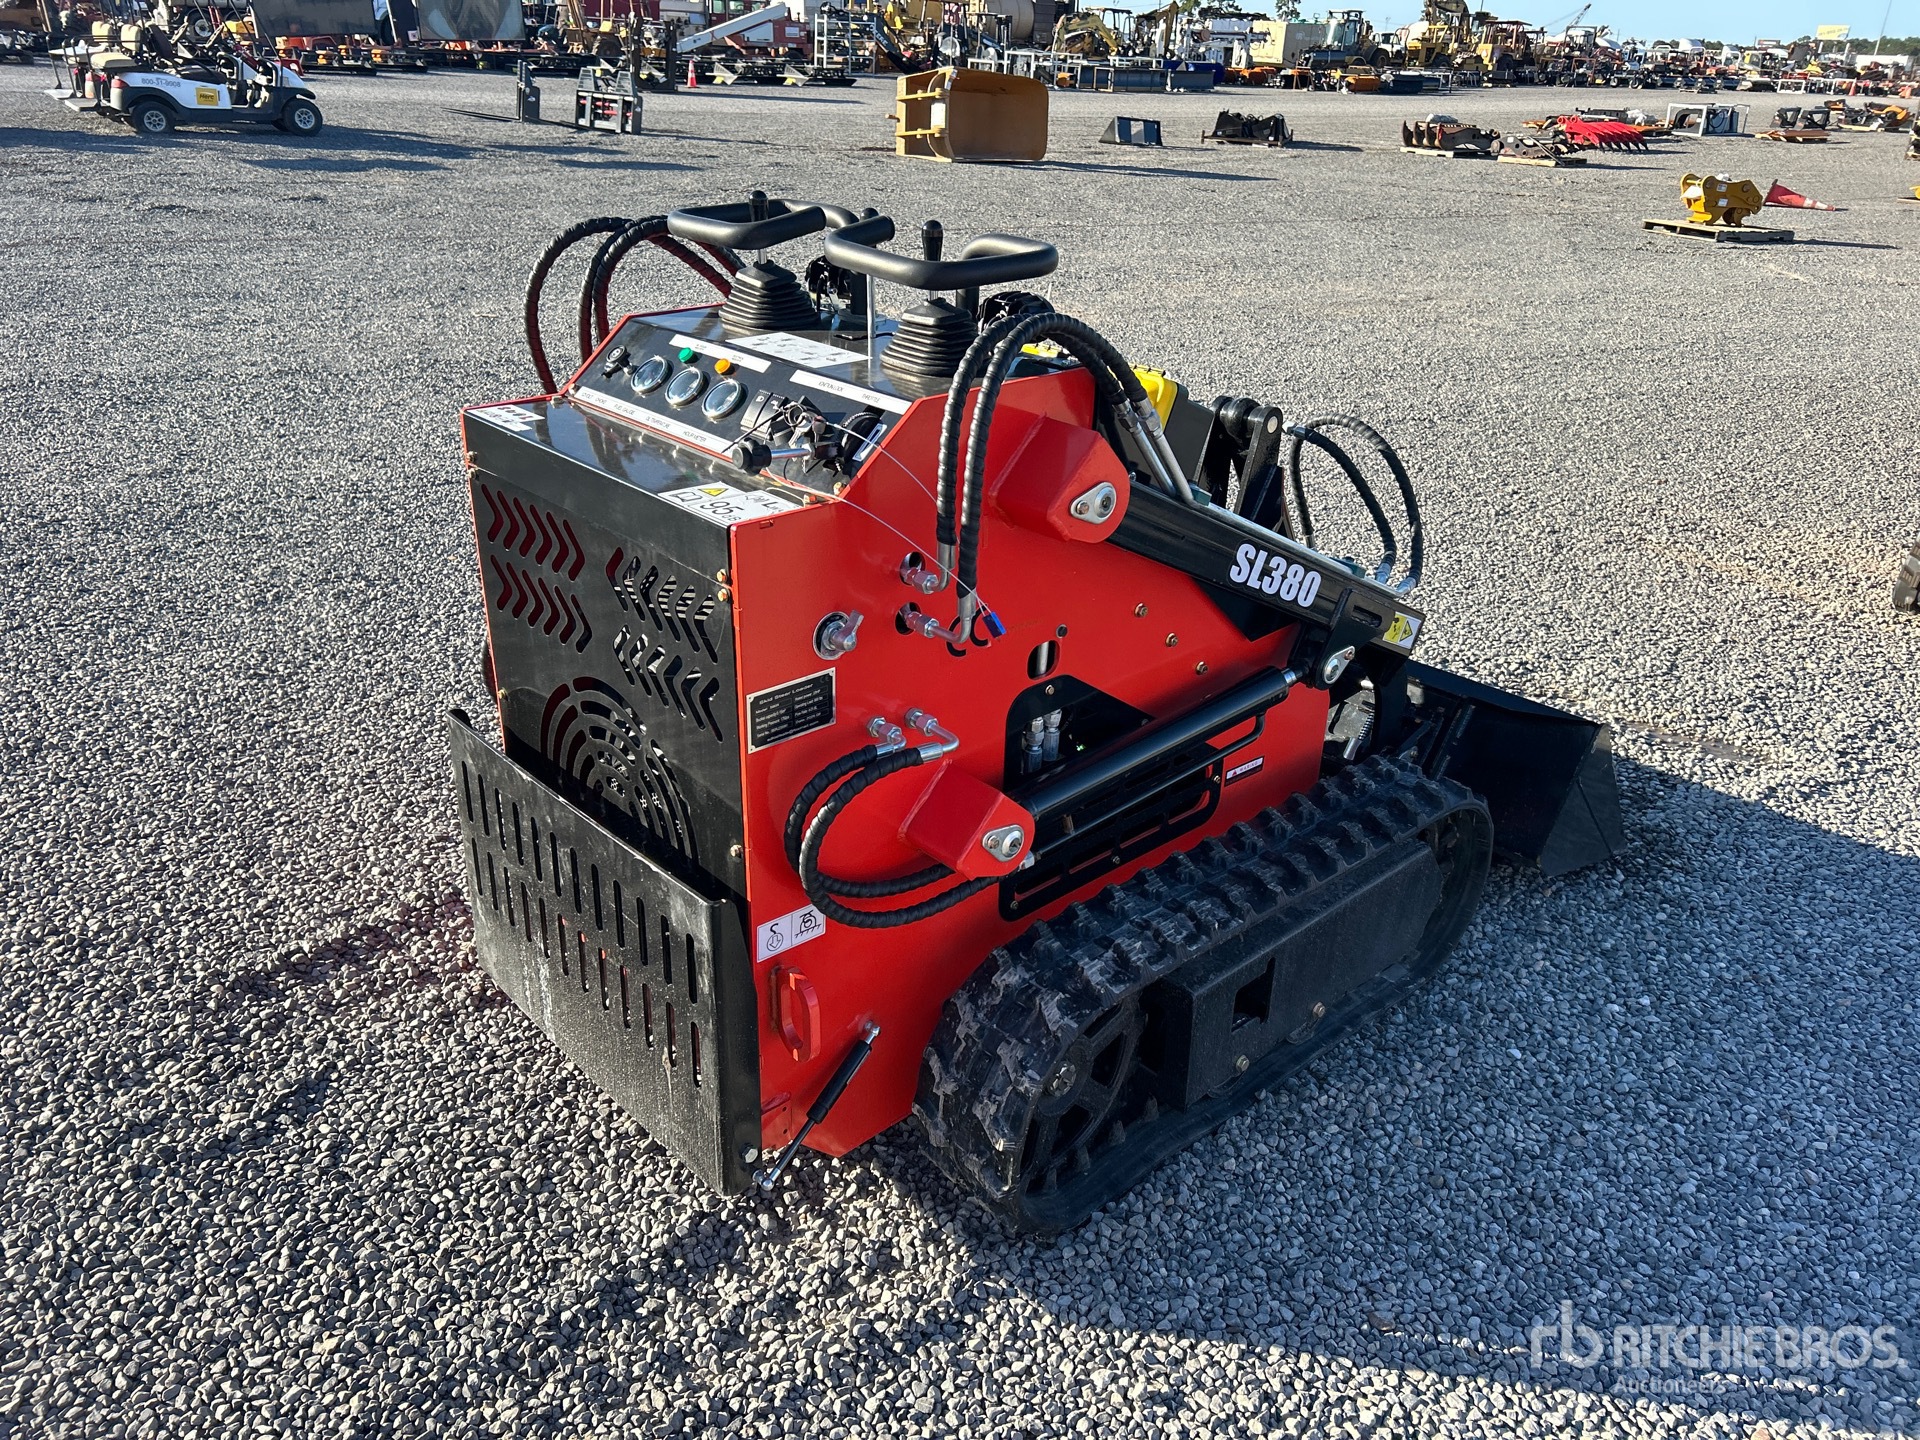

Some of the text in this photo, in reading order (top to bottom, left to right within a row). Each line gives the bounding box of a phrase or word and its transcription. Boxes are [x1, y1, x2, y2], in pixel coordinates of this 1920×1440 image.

[699, 501, 744, 515] 95
[1229, 543, 1322, 608] SL380
[792, 684, 813, 693] Loader
